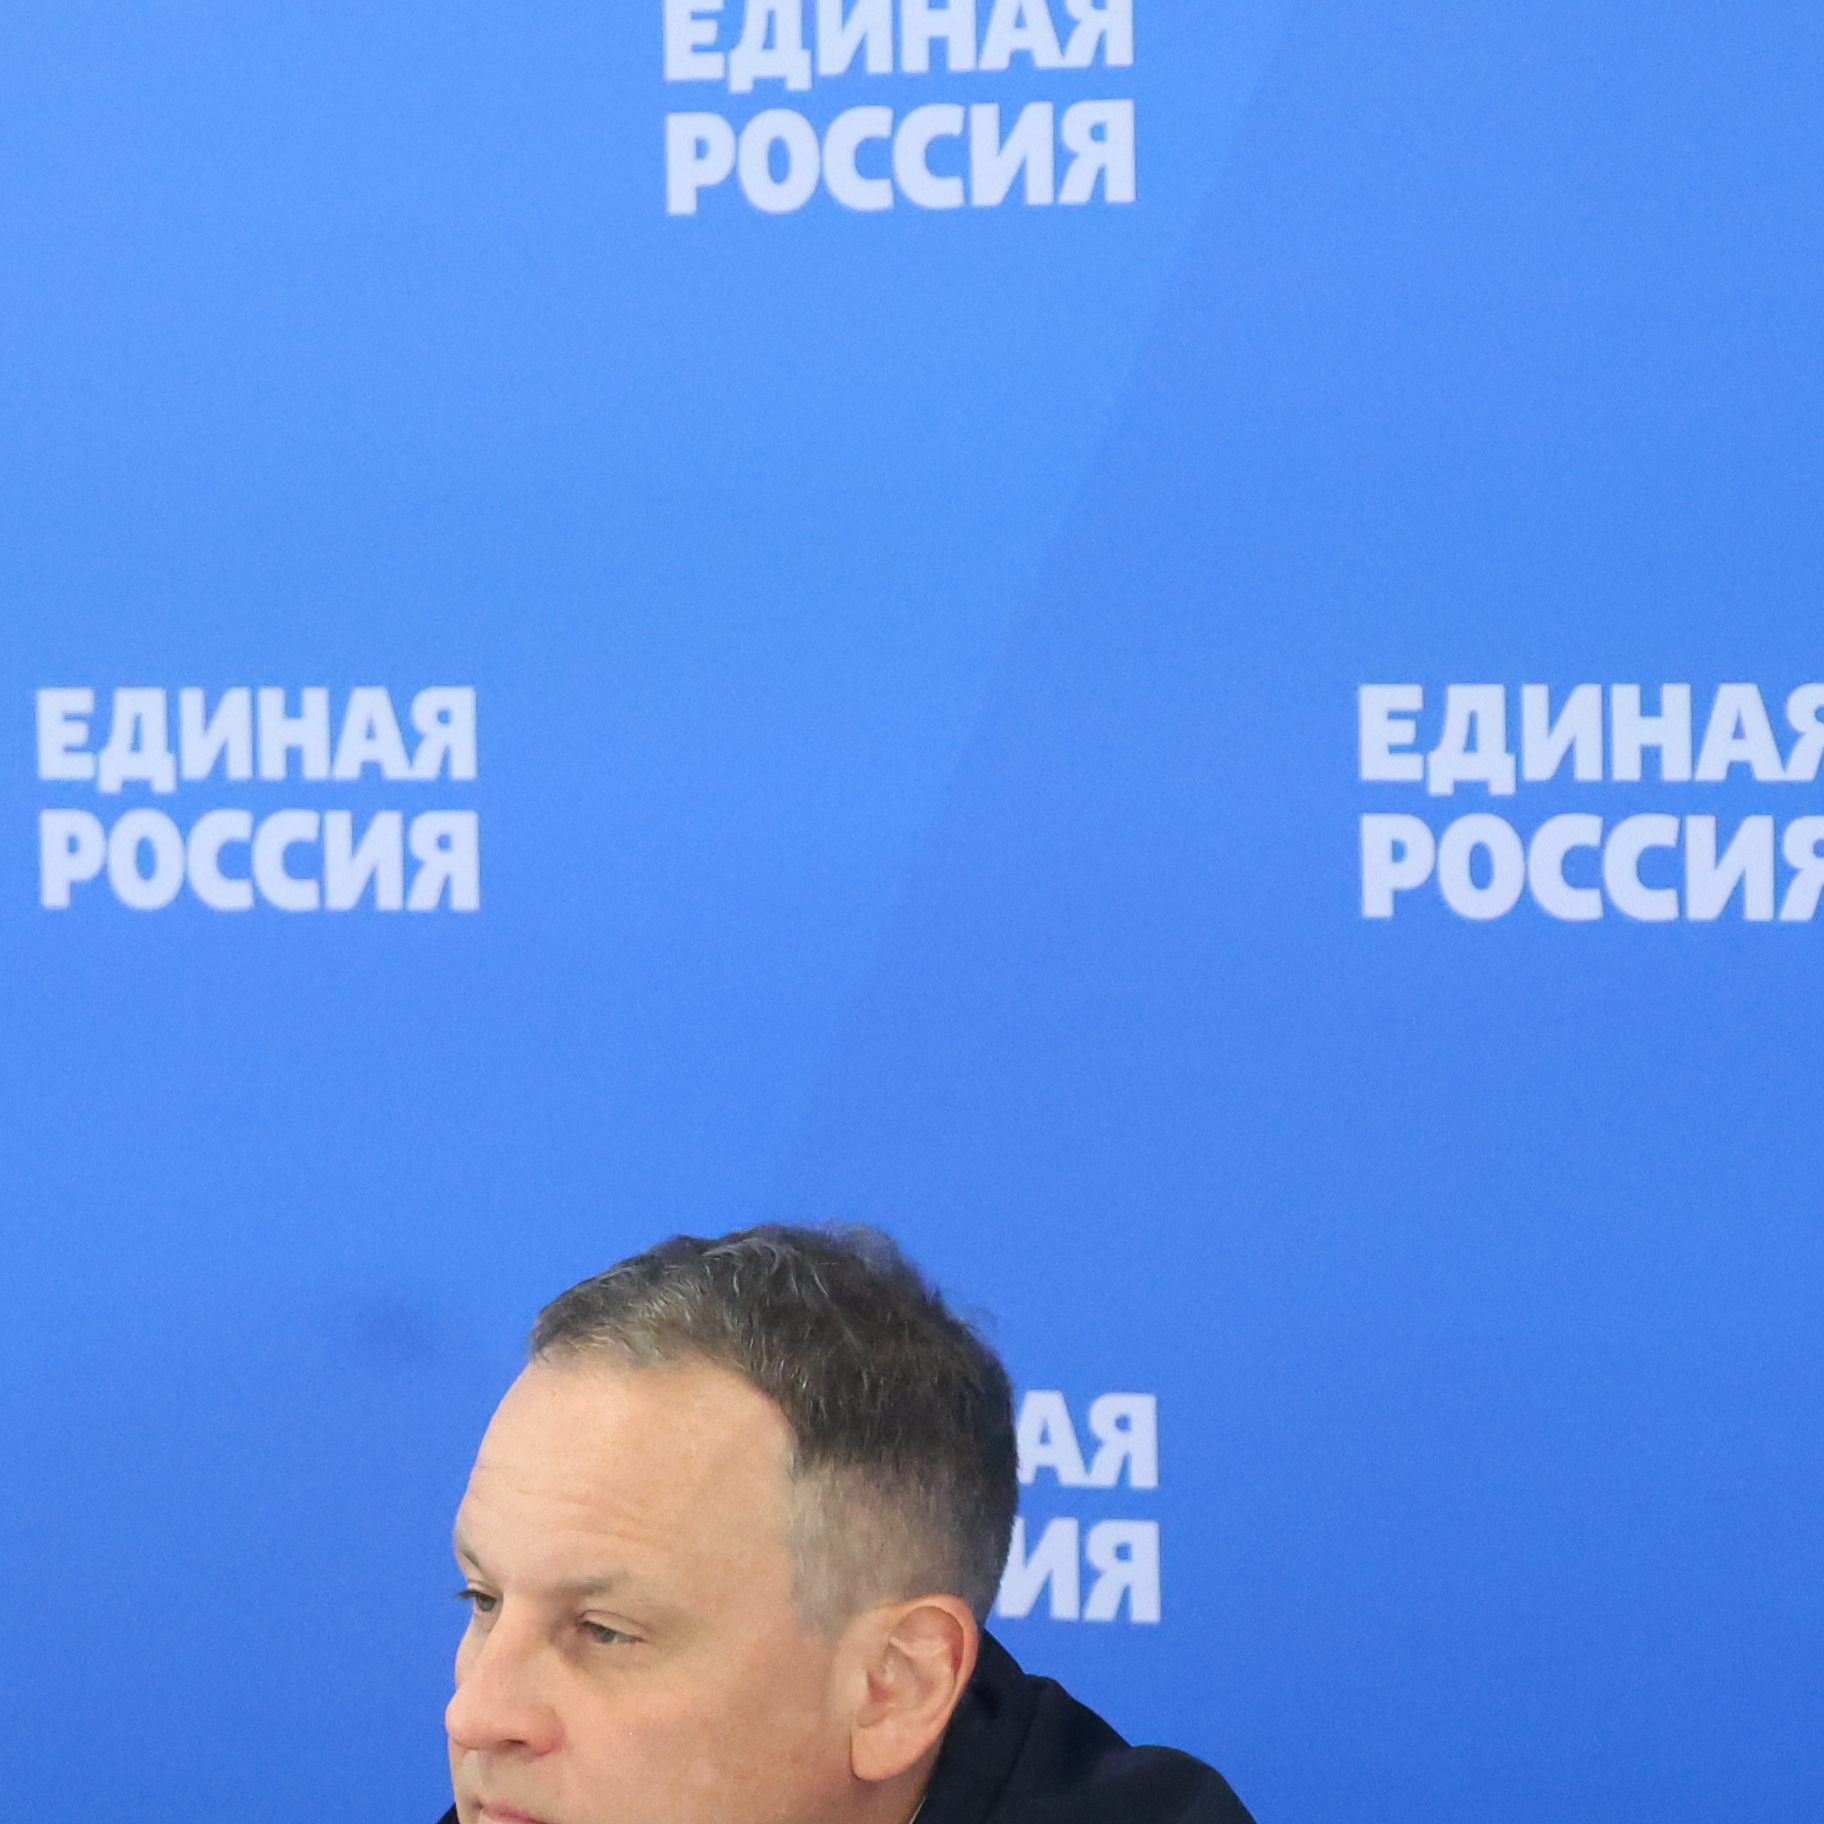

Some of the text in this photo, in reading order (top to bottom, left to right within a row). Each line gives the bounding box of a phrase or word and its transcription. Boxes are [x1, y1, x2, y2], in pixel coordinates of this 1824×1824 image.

[661, 0, 1136, 96] ЕДИНАЯ
[663, 98, 1137, 217] РОССИЯ
[35, 685, 479, 795] ЕДИНАЯ
[38, 806, 482, 913] РОССИЯ
